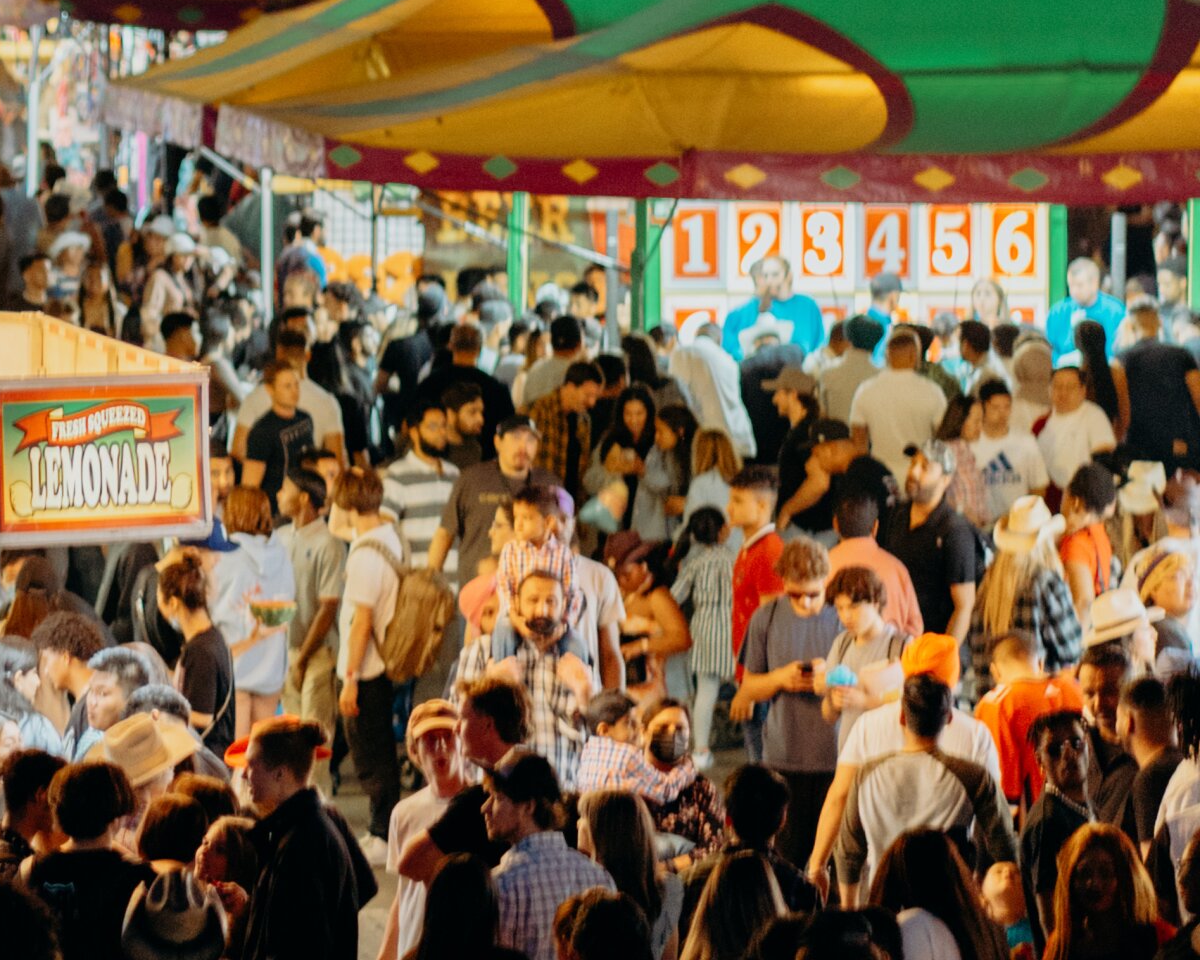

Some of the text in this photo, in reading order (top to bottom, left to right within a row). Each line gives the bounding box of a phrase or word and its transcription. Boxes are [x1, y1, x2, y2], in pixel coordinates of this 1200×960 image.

[681, 211, 1033, 276] 1 2 3 4 5 6
[51, 404, 146, 441] FRESH SQUEEZED
[29, 440, 172, 511] LEMONADE
